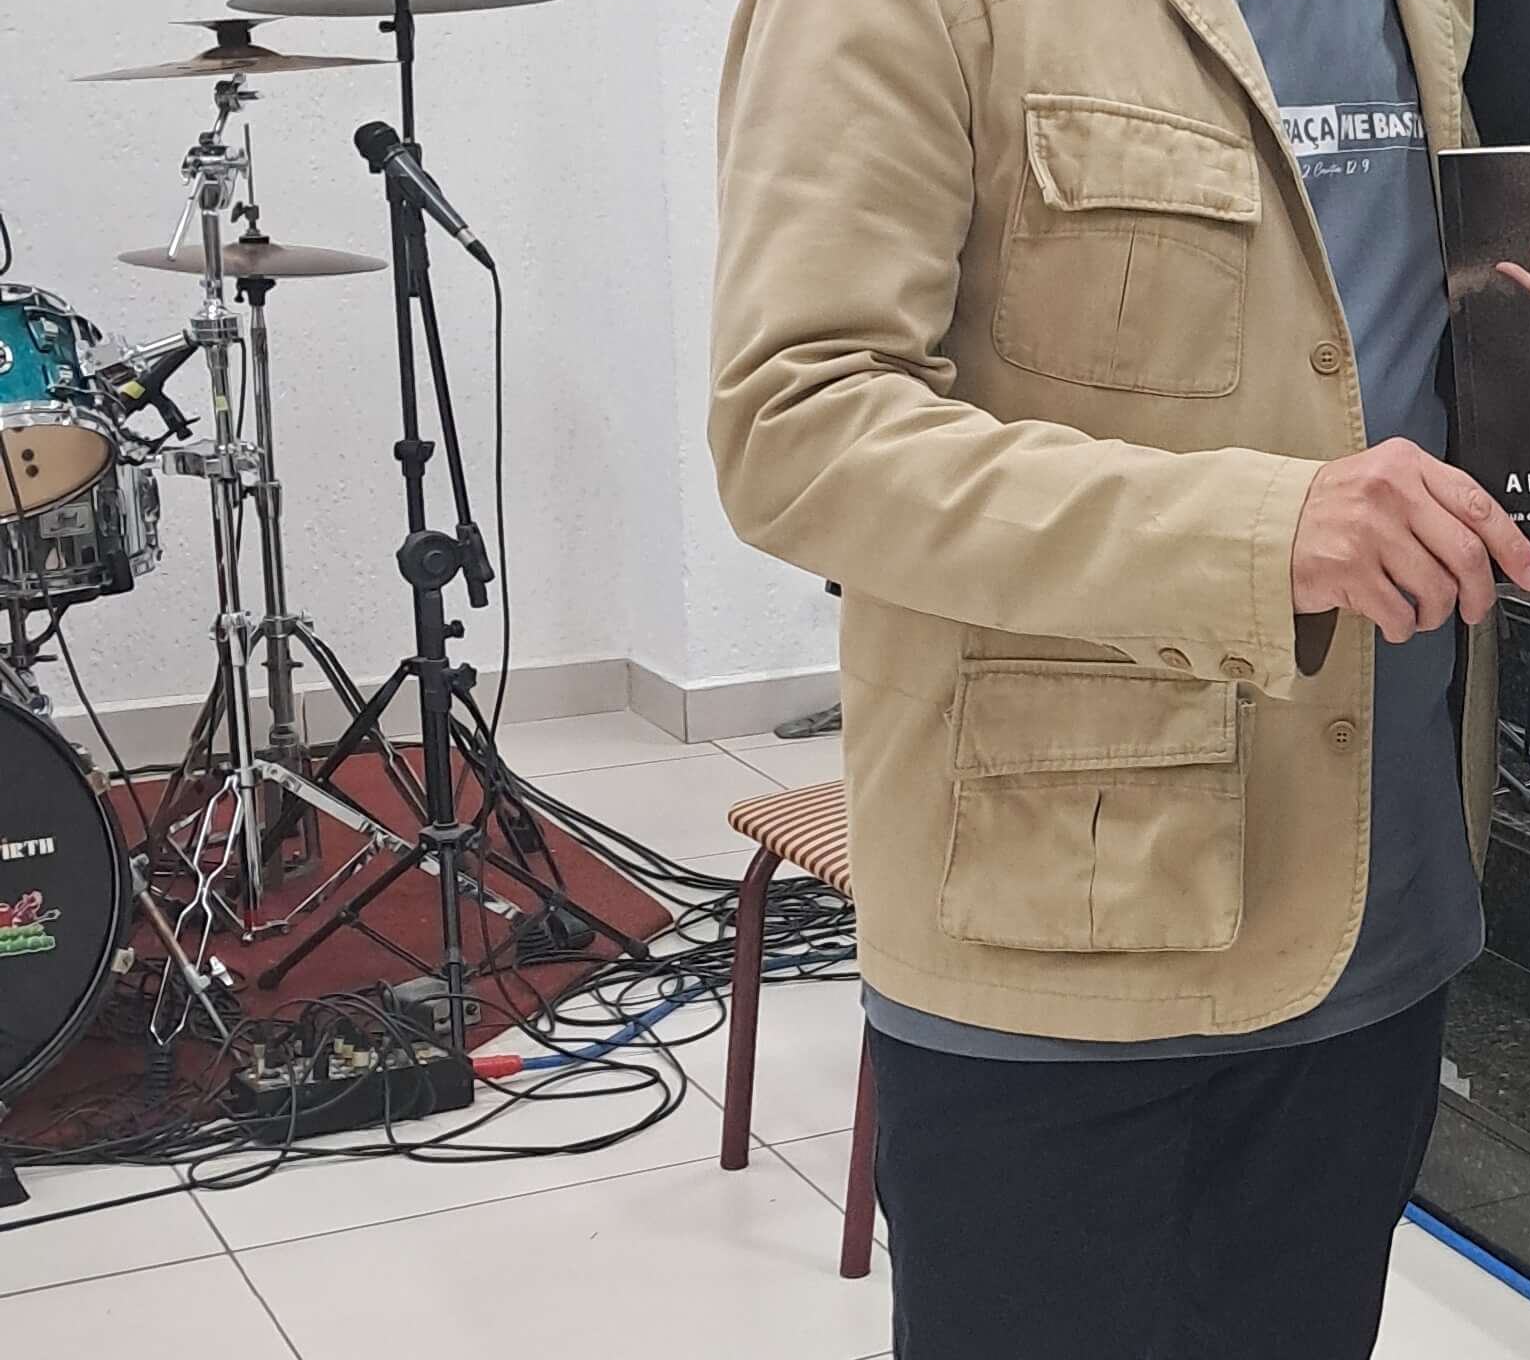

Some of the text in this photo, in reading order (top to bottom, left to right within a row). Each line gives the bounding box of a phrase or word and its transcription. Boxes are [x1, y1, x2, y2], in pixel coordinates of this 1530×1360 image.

[1282, 116, 1335, 150] RAÇA
[1341, 113, 1371, 141] ME
[1505, 473, 1523, 493] A
